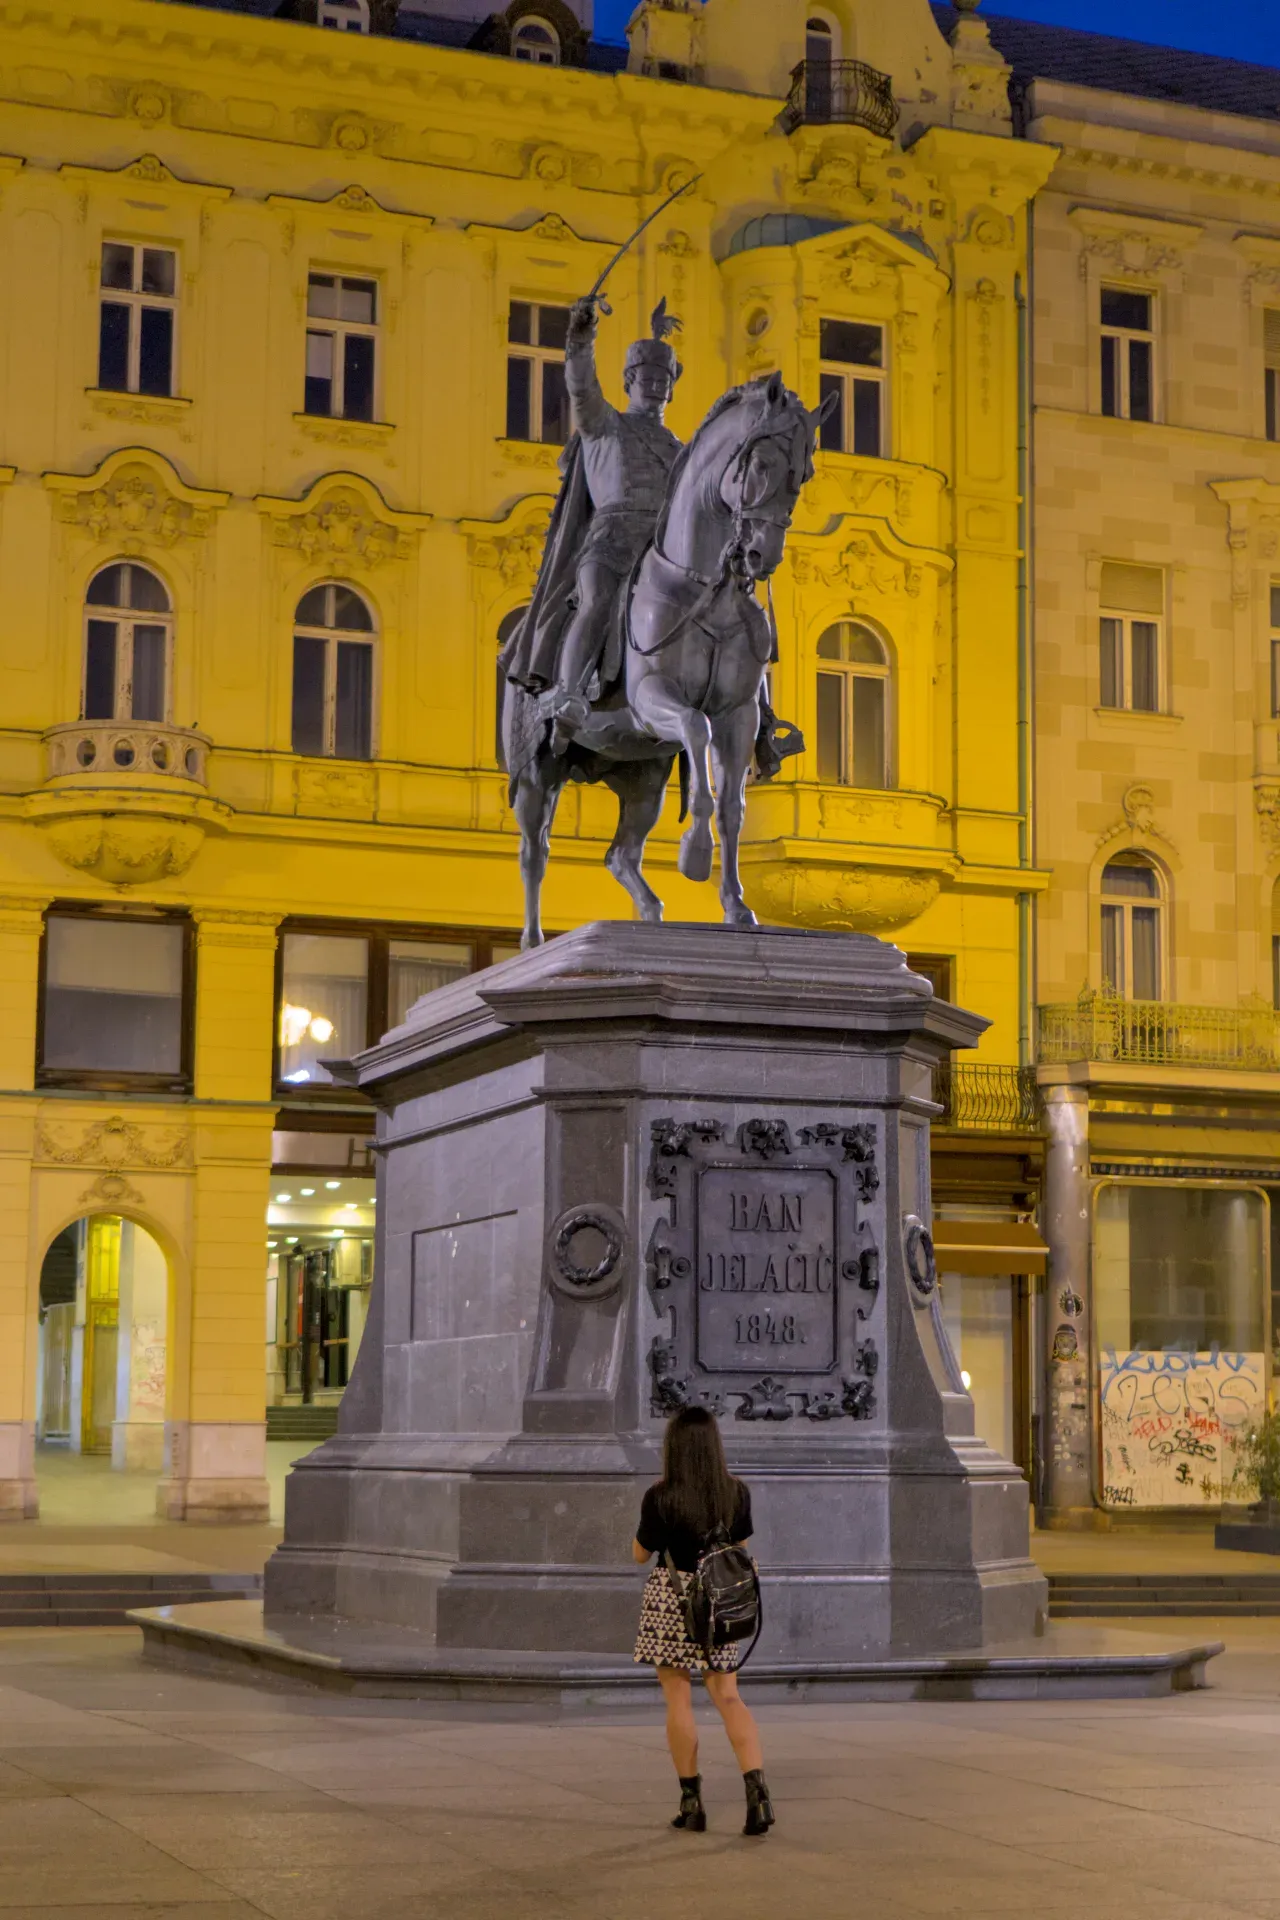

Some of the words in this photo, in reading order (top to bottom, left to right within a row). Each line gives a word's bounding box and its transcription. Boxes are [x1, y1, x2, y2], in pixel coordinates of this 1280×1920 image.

[730, 1192, 804, 1233] BAN
[700, 1243, 833, 1293] JELAČIĆ
[735, 1313, 808, 1344] 1848.
